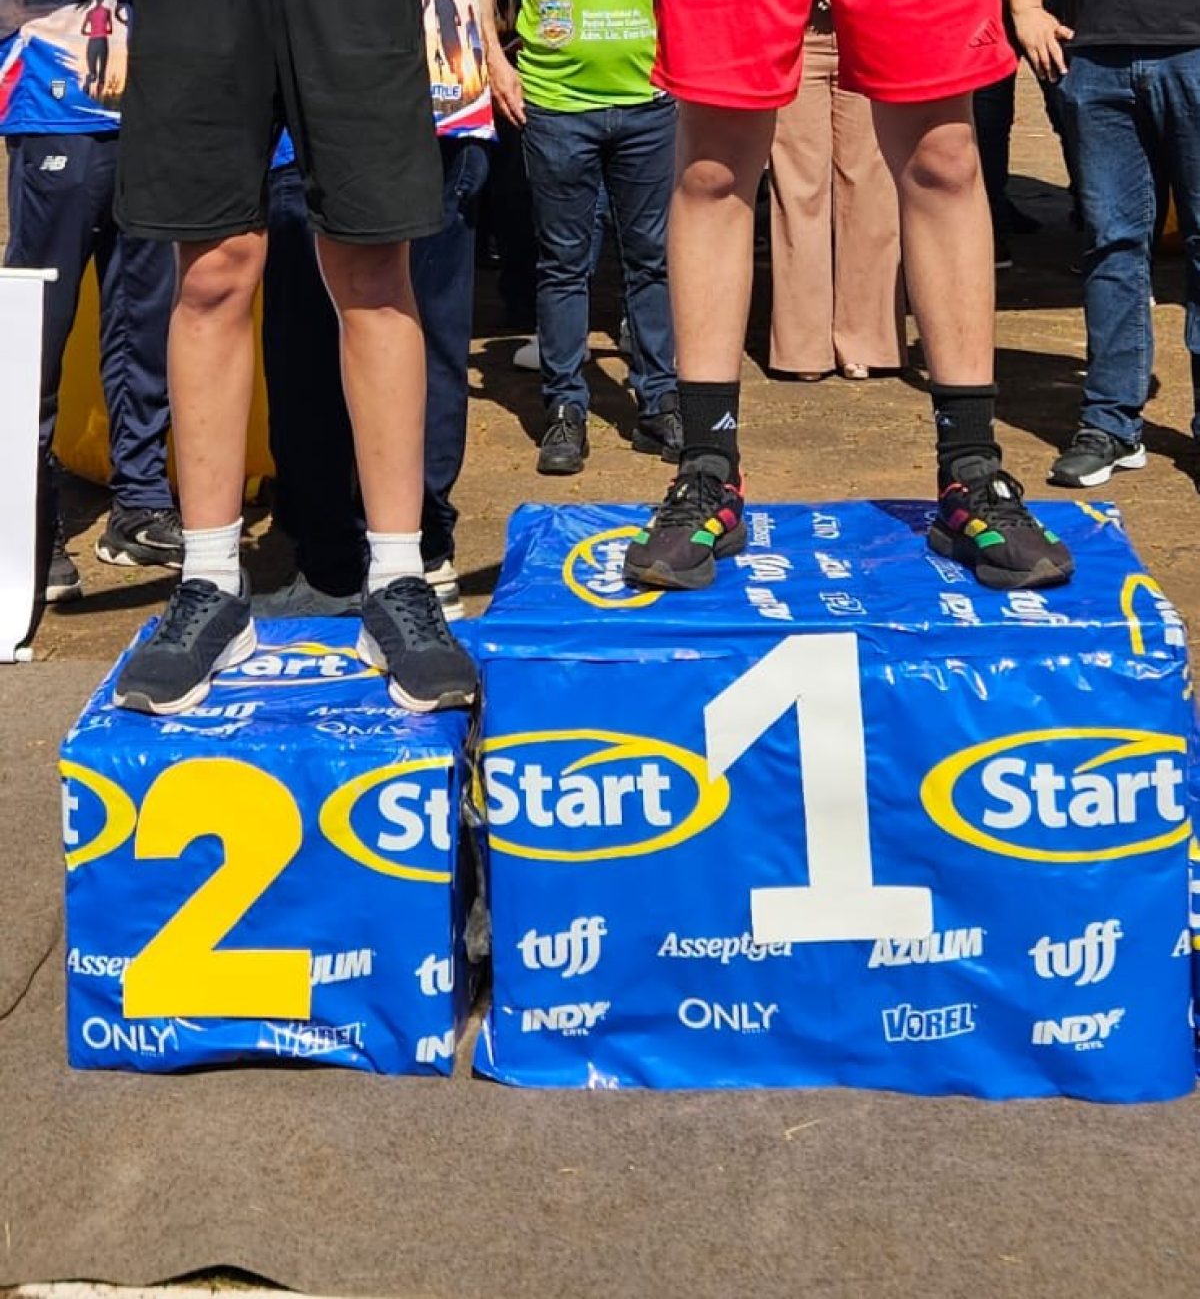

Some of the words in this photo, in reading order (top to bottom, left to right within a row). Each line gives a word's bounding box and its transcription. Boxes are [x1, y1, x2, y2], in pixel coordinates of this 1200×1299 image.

[228, 654, 348, 677] art
[484, 758, 672, 827] Start
[704, 632, 934, 943] 1
[982, 757, 1185, 829] Start
[123, 757, 311, 1019] 2
[517, 915, 608, 978] tuff
[867, 926, 984, 969] AZULIM
[1028, 919, 1124, 986] tuff
[82, 1016, 174, 1054] ONLY
[521, 1001, 611, 1032] INDY
[678, 997, 780, 1032] ONLY
[882, 1003, 976, 1042] VOREL
[1032, 1007, 1126, 1044] INDY
